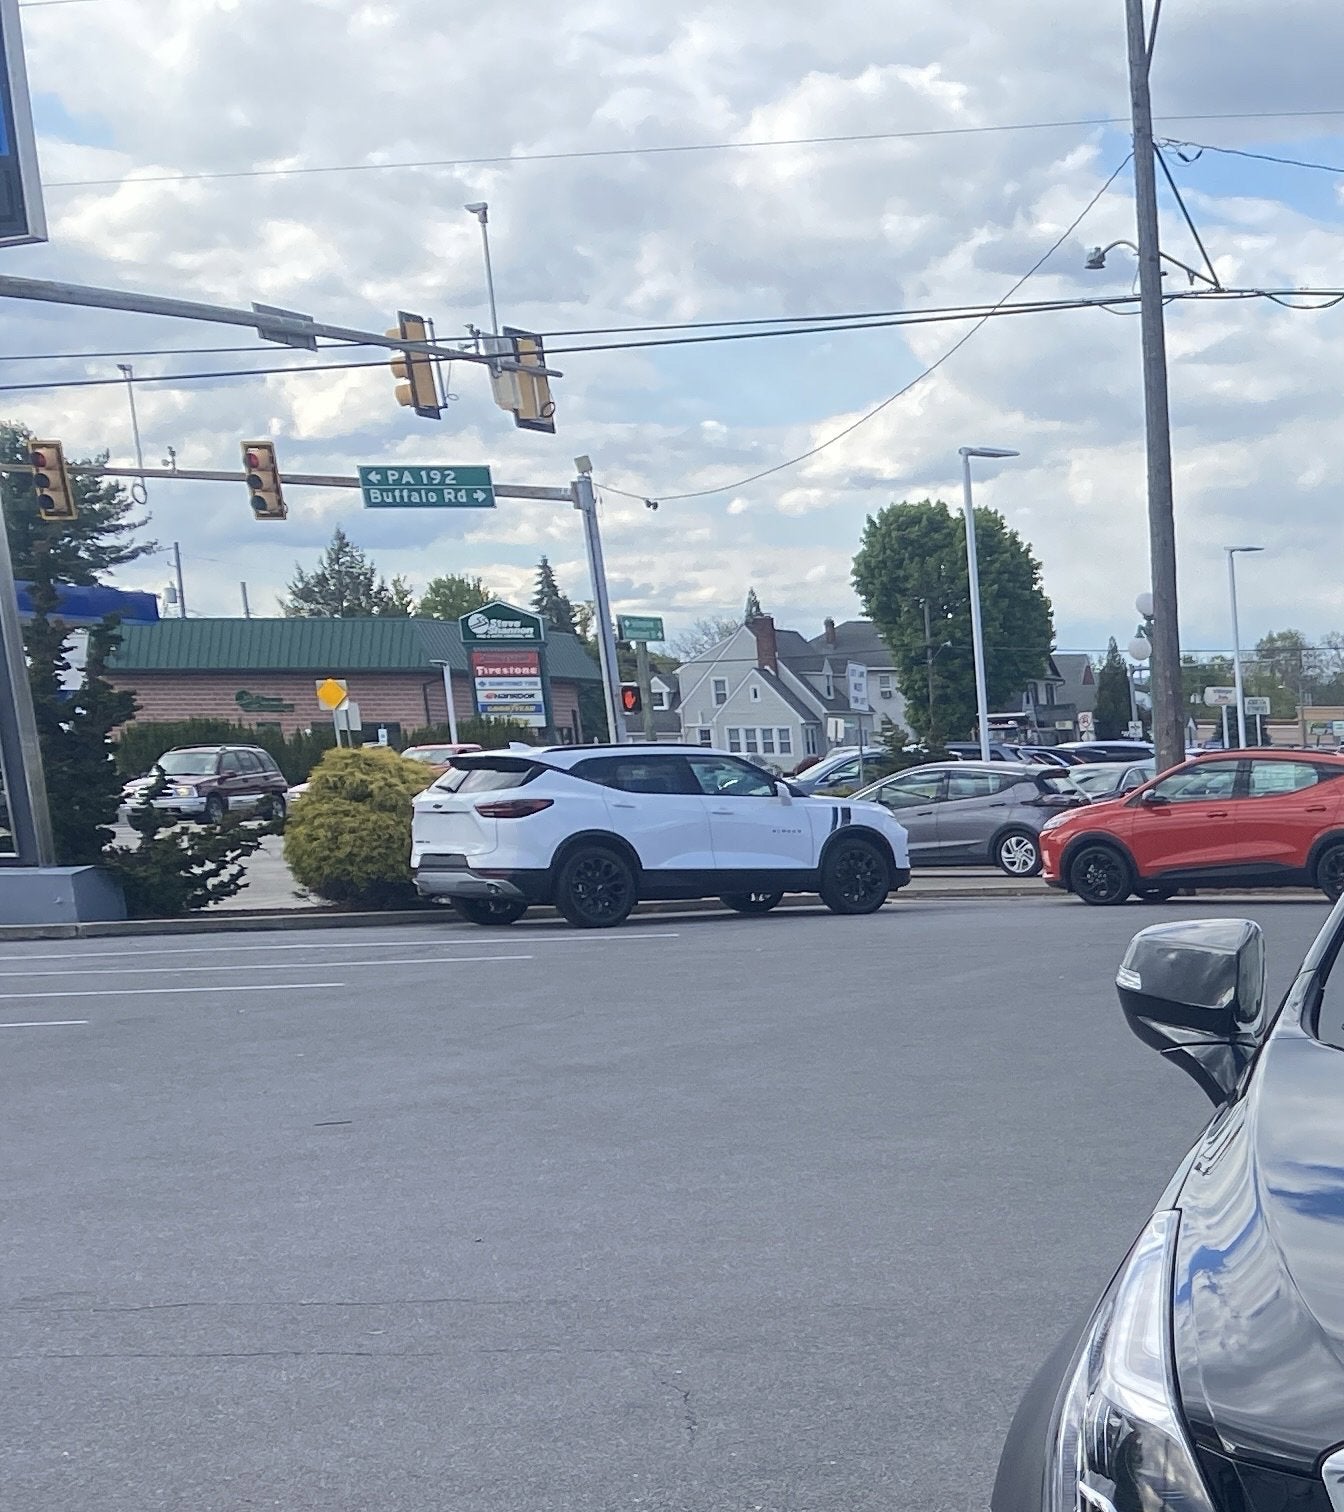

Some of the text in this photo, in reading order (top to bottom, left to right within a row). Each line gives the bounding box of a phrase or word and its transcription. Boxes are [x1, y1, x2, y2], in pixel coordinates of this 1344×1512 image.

[386, 470, 457, 484] PA 192
[369, 489, 467, 502] Buffalo Rd
[490, 619, 522, 628] Steve
[487, 627, 535, 635] Shannon
[476, 666, 538, 676] Firestone
